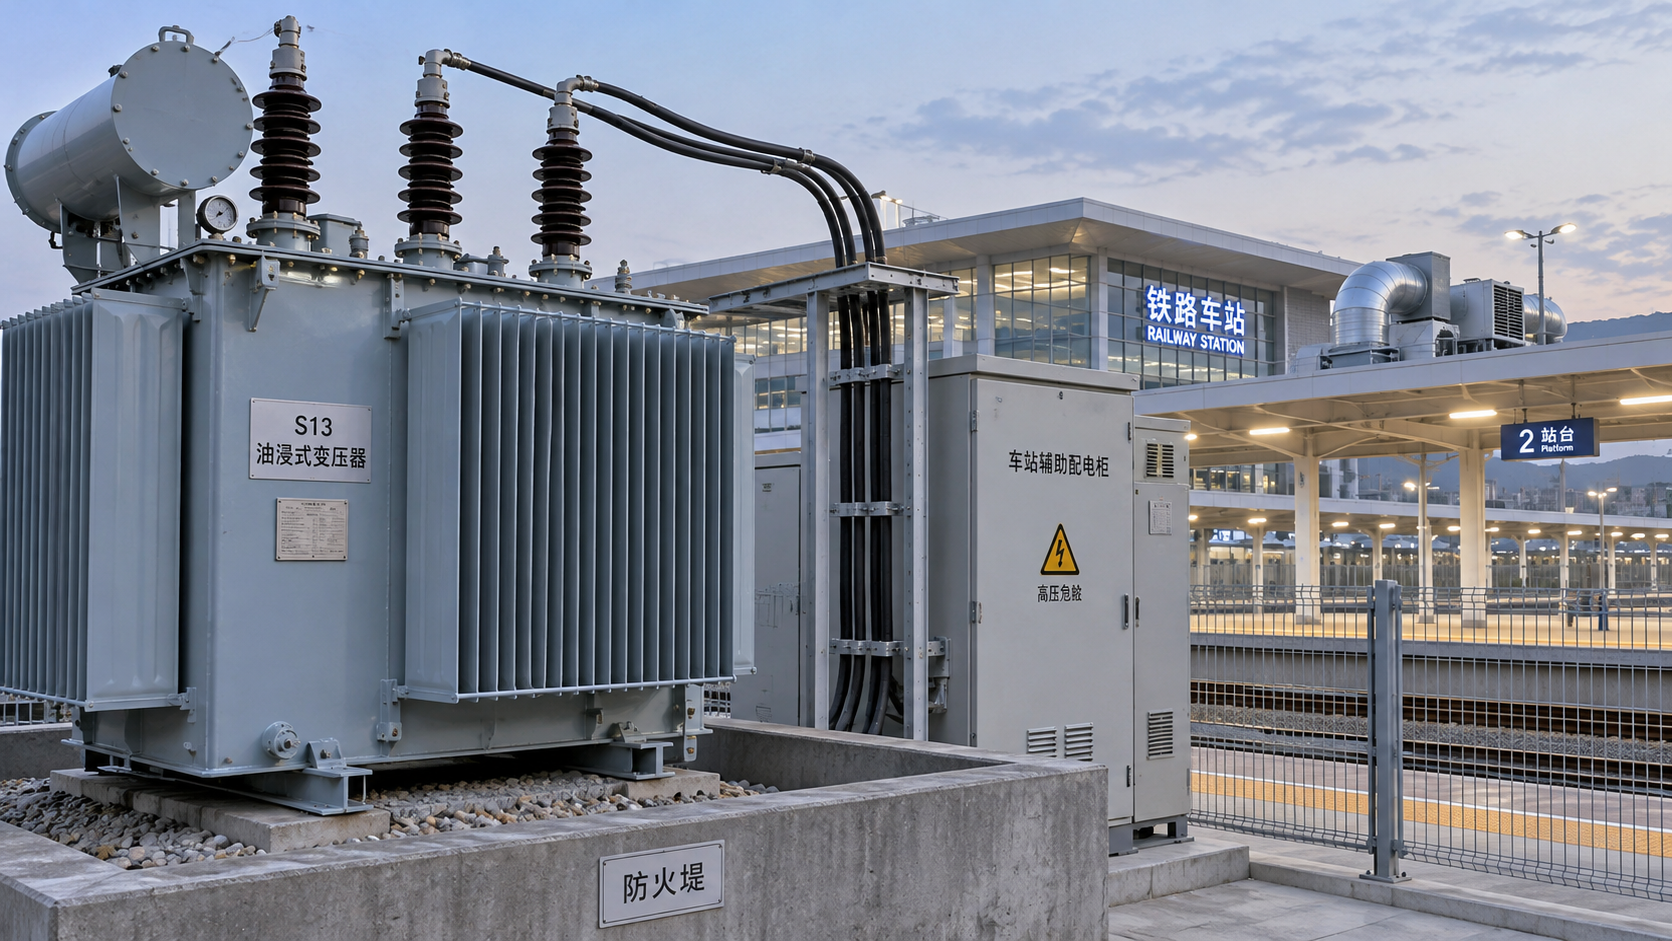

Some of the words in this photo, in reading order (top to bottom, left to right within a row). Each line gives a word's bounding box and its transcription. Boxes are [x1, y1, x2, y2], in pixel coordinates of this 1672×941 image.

[1147, 285, 1245, 336] 铁路车站
[1147, 325, 1197, 347] RAILWAY
[1200, 334, 1245, 354] STATION
[294, 415, 332, 436] S13
[1519, 429, 1534, 453] 2
[1541, 426, 1574, 443] 站台
[256, 442, 366, 468] 油浸式变压器
[1541, 444, 1573, 452] Platform
[1008, 449, 1109, 478] 车站辅助配电柜
[624, 862, 704, 904] 防火堤
